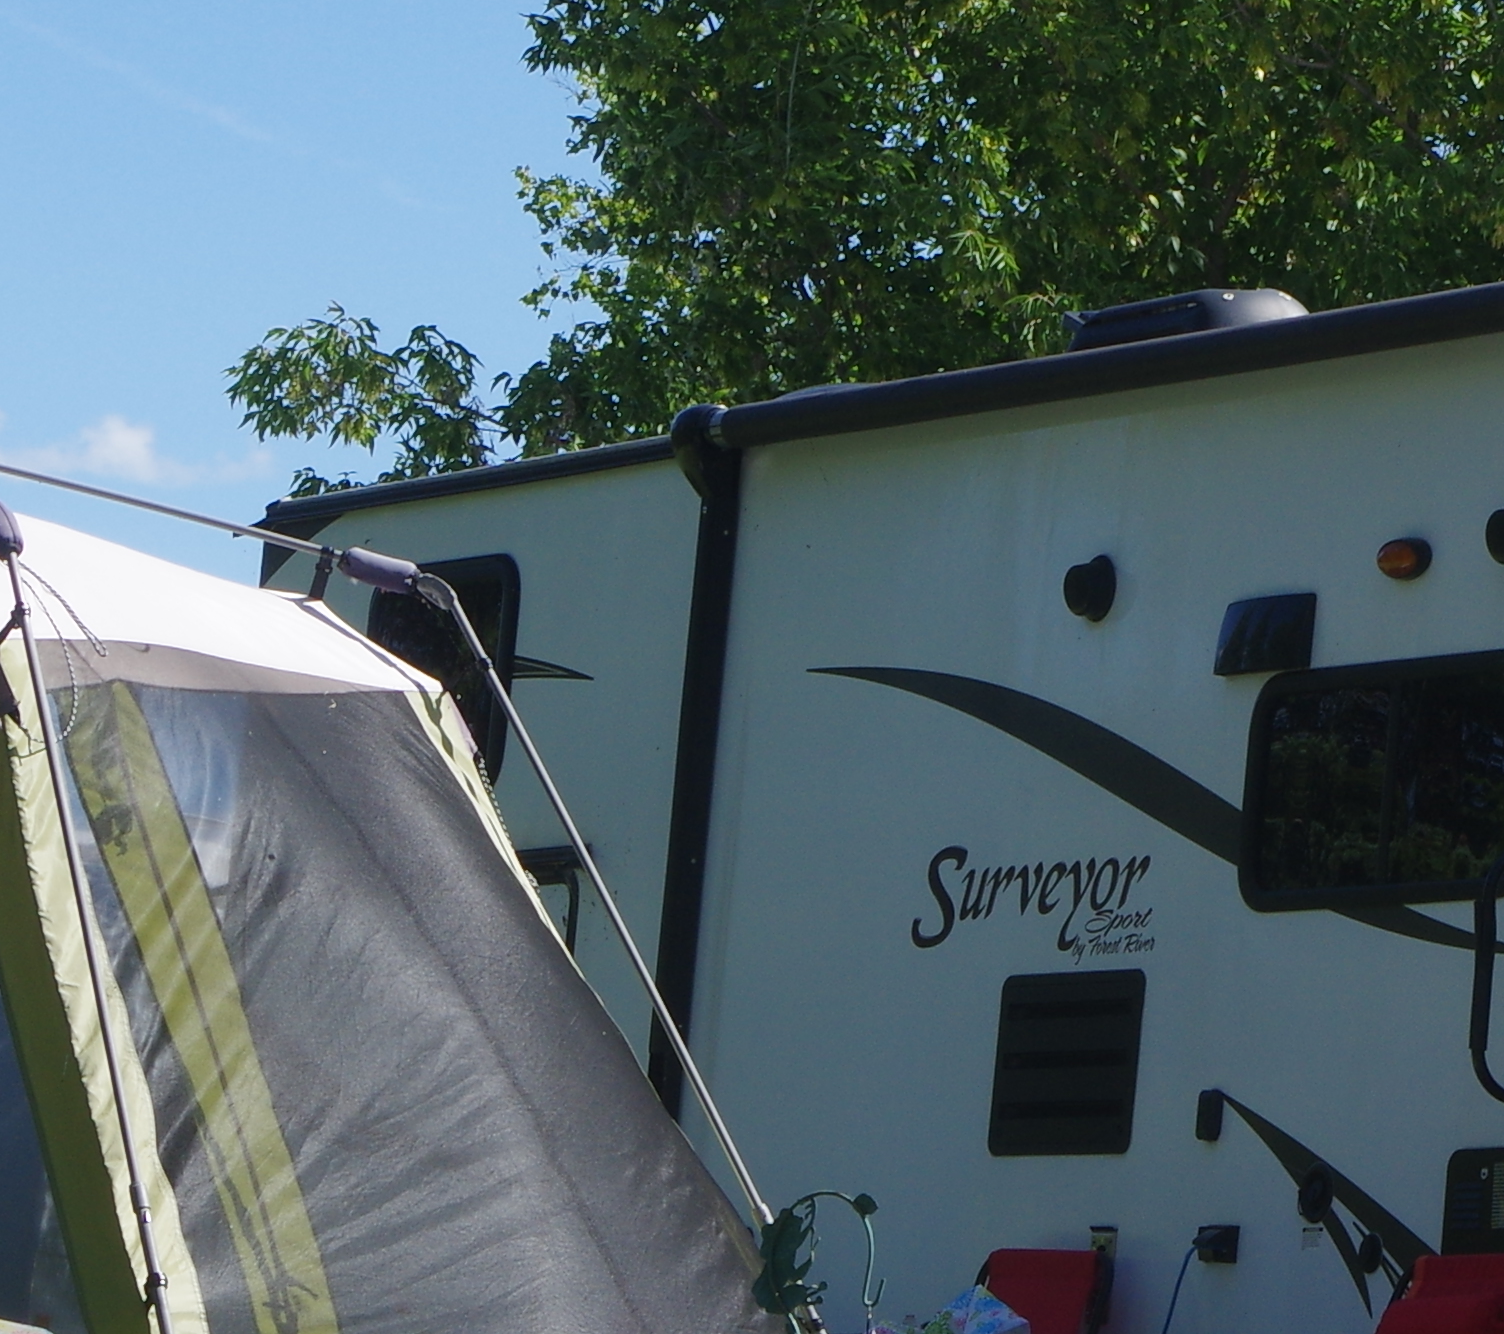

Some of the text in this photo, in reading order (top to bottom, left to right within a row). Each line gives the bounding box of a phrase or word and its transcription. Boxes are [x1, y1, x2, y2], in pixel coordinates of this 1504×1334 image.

[911, 845, 1152, 951] Surveyor
[1084, 907, 1153, 937] Sport
[1072, 932, 1156, 966] by Forest River
